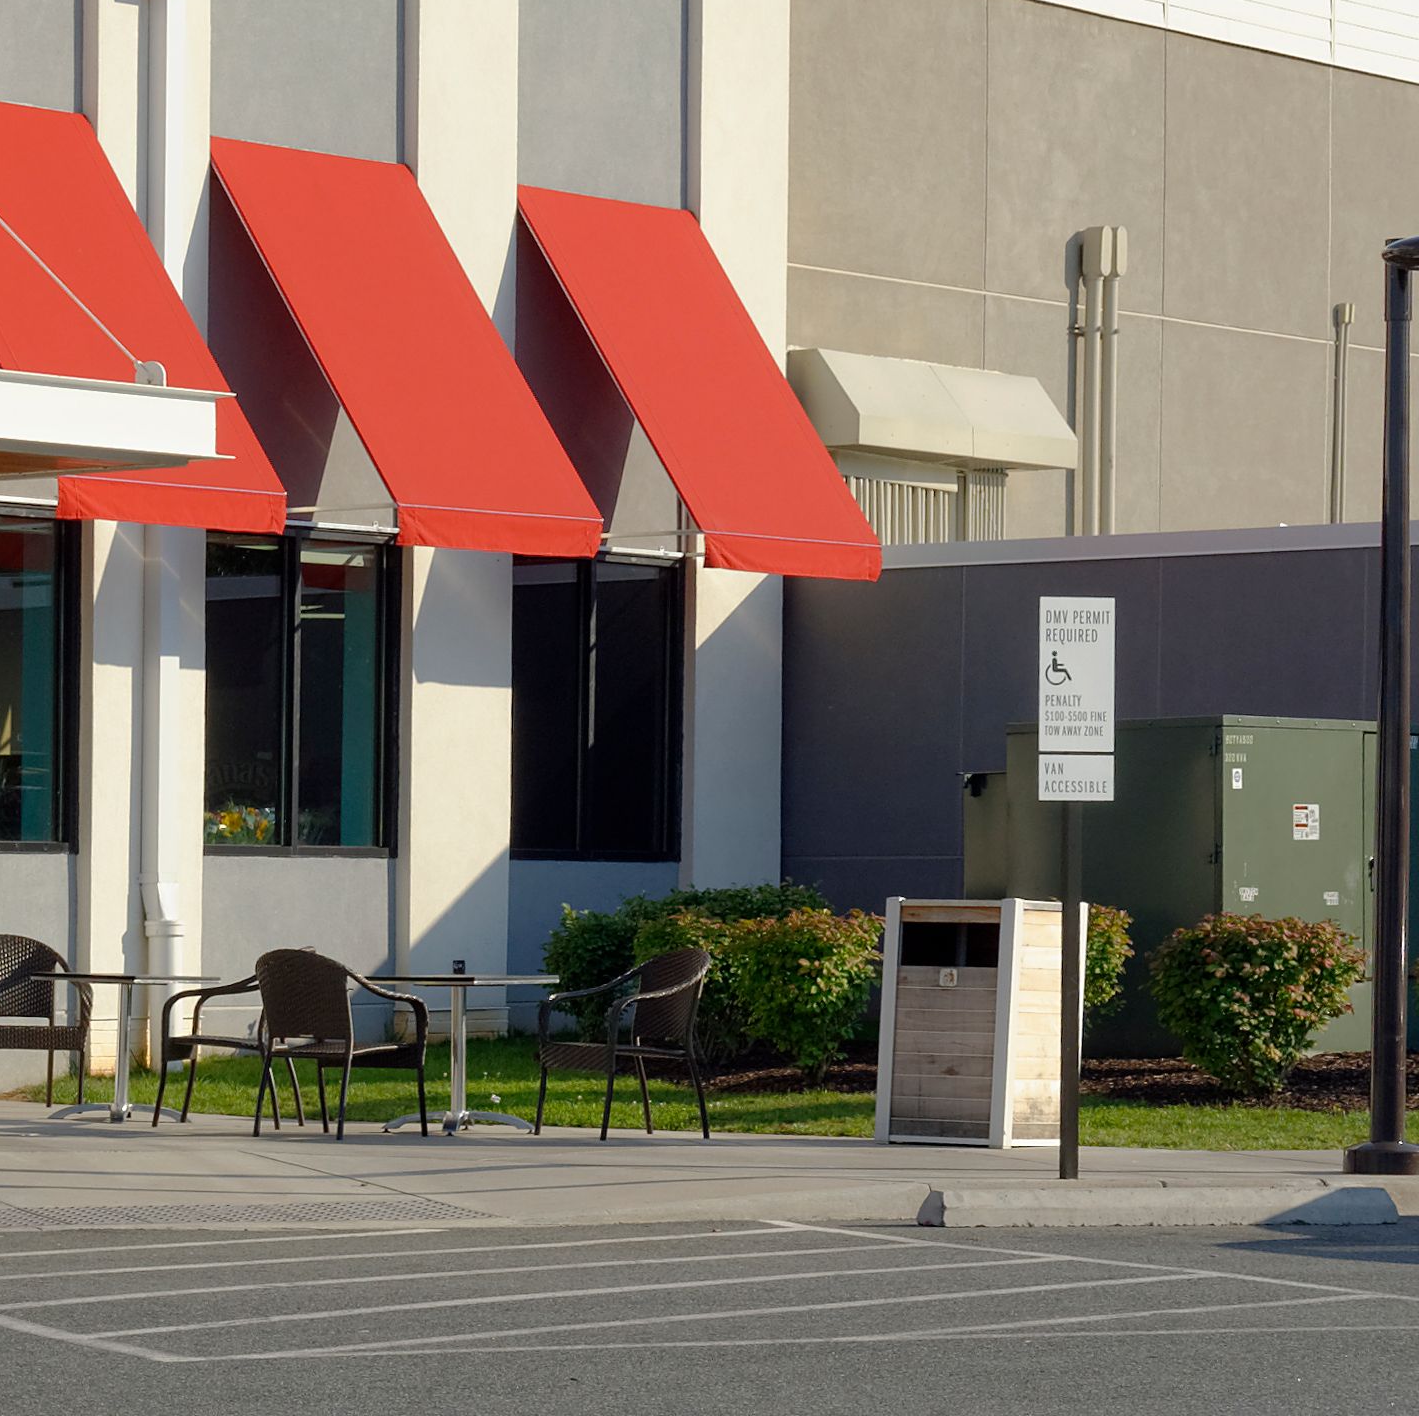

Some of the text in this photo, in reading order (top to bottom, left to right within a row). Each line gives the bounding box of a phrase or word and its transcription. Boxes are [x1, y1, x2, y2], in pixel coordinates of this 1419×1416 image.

[1045, 610, 1110, 625] DMV PERMIT
[1045, 629, 1098, 644] REQUIRED
[1045, 695, 1082, 707] PENALTY
[1045, 710, 1107, 723] $100-$500 FINE
[1045, 725, 1104, 737] TOW AWAY ZONE
[1044, 763, 1064, 775] VAN
[1044, 780, 1107, 793] ACCESSIBLE
